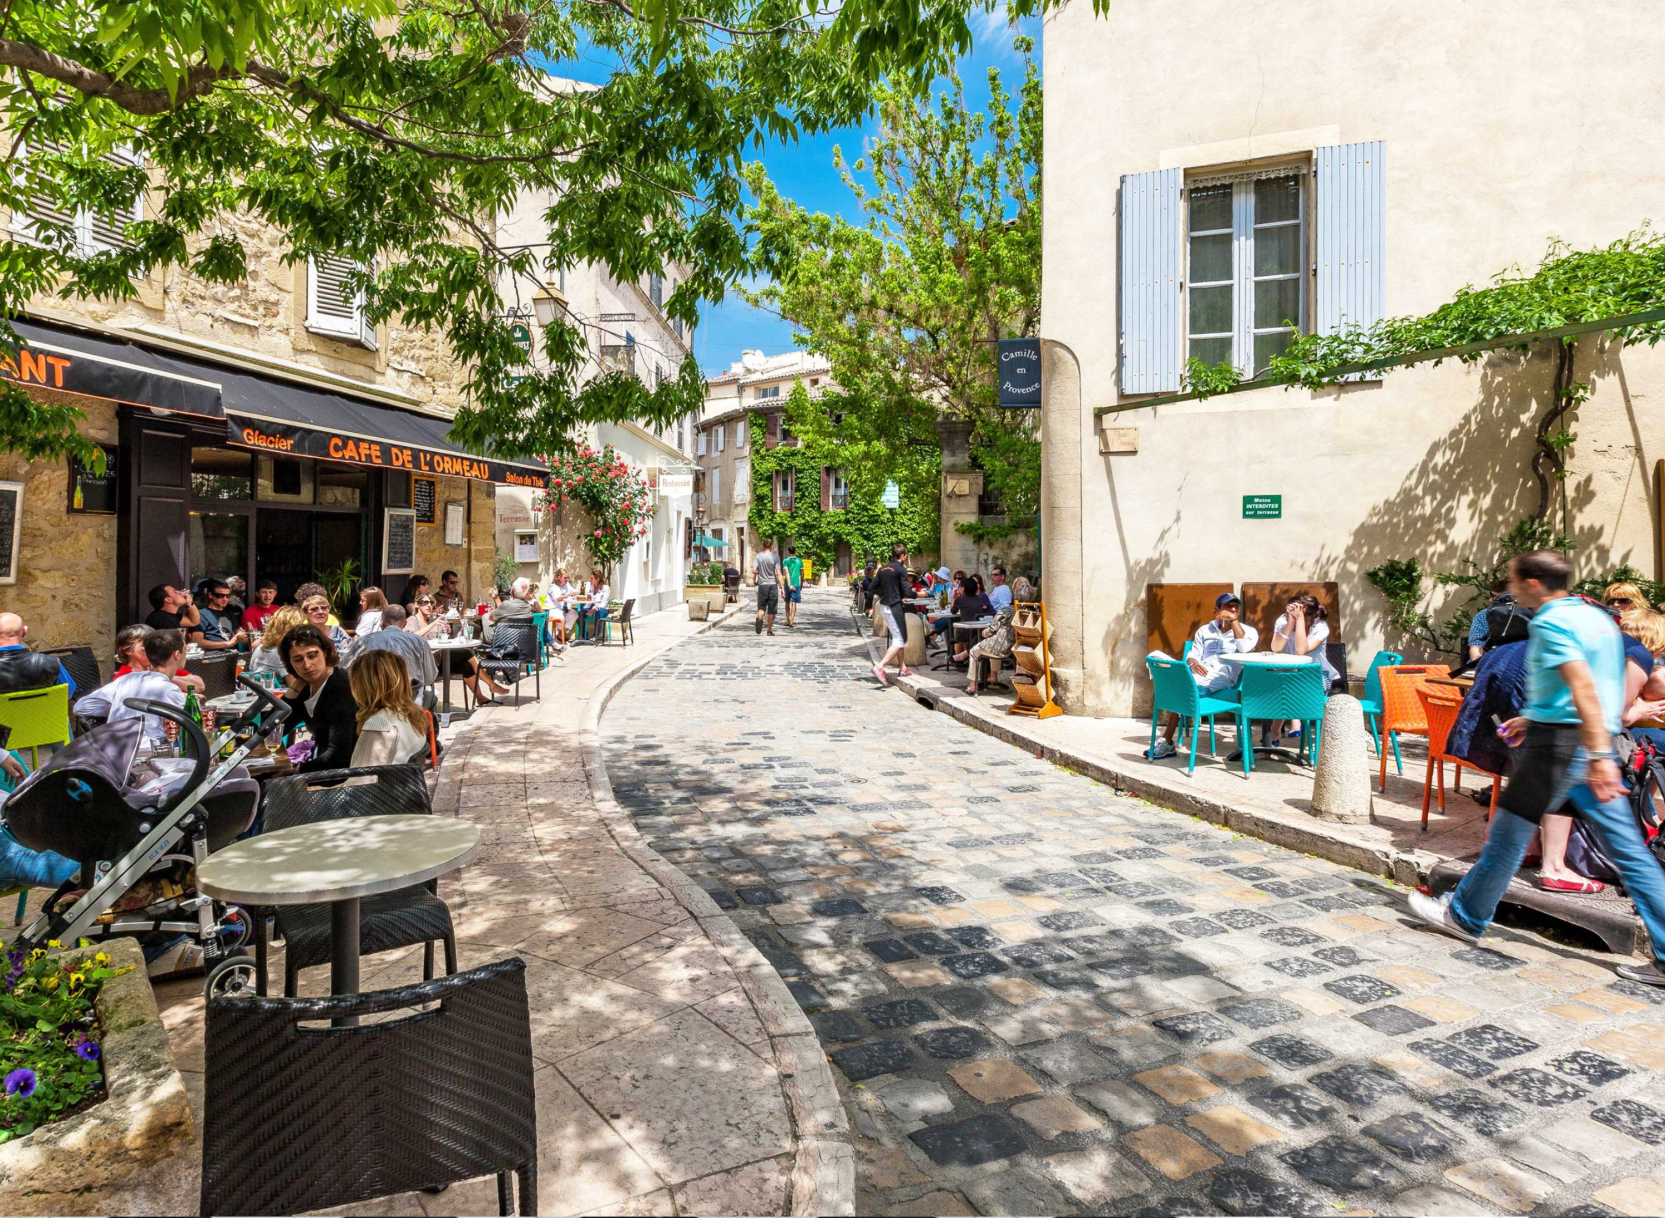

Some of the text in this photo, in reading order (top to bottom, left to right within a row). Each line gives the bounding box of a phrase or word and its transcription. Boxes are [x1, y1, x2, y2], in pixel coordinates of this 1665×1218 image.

[1001, 349, 1038, 361] Camille
[1003, 381, 1041, 394] Provence
[242, 428, 294, 451] Glacier
[329, 437, 383, 463] CAFE
[390, 447, 413, 468] DE
[505, 471, 523, 485] Salon
[524, 475, 531, 485] de
[662, 477, 690, 488] Restaurant
[498, 513, 530, 523] Terrasse
